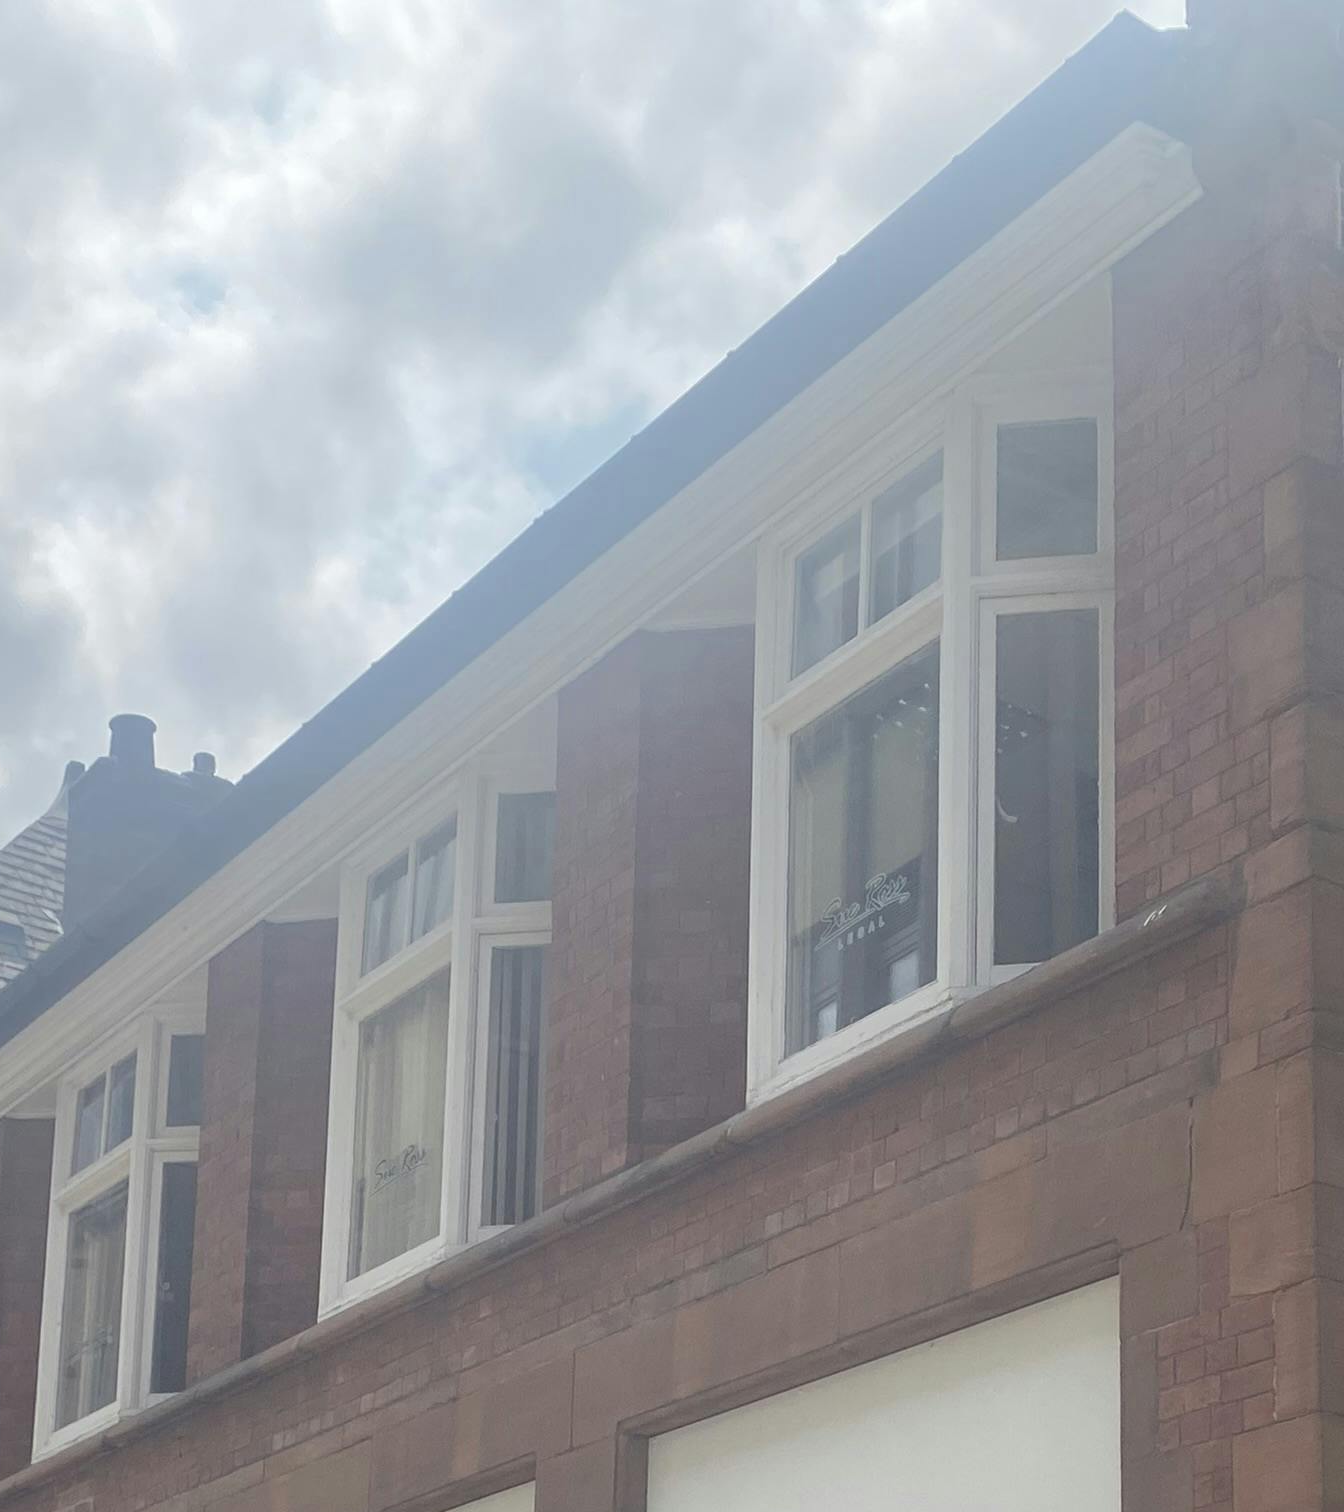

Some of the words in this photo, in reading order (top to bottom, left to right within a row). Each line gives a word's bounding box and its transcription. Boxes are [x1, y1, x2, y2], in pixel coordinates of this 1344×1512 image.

[820, 896, 861, 941] Sue
[864, 872, 911, 912] Ross
[837, 915, 885, 951] LEGAL
